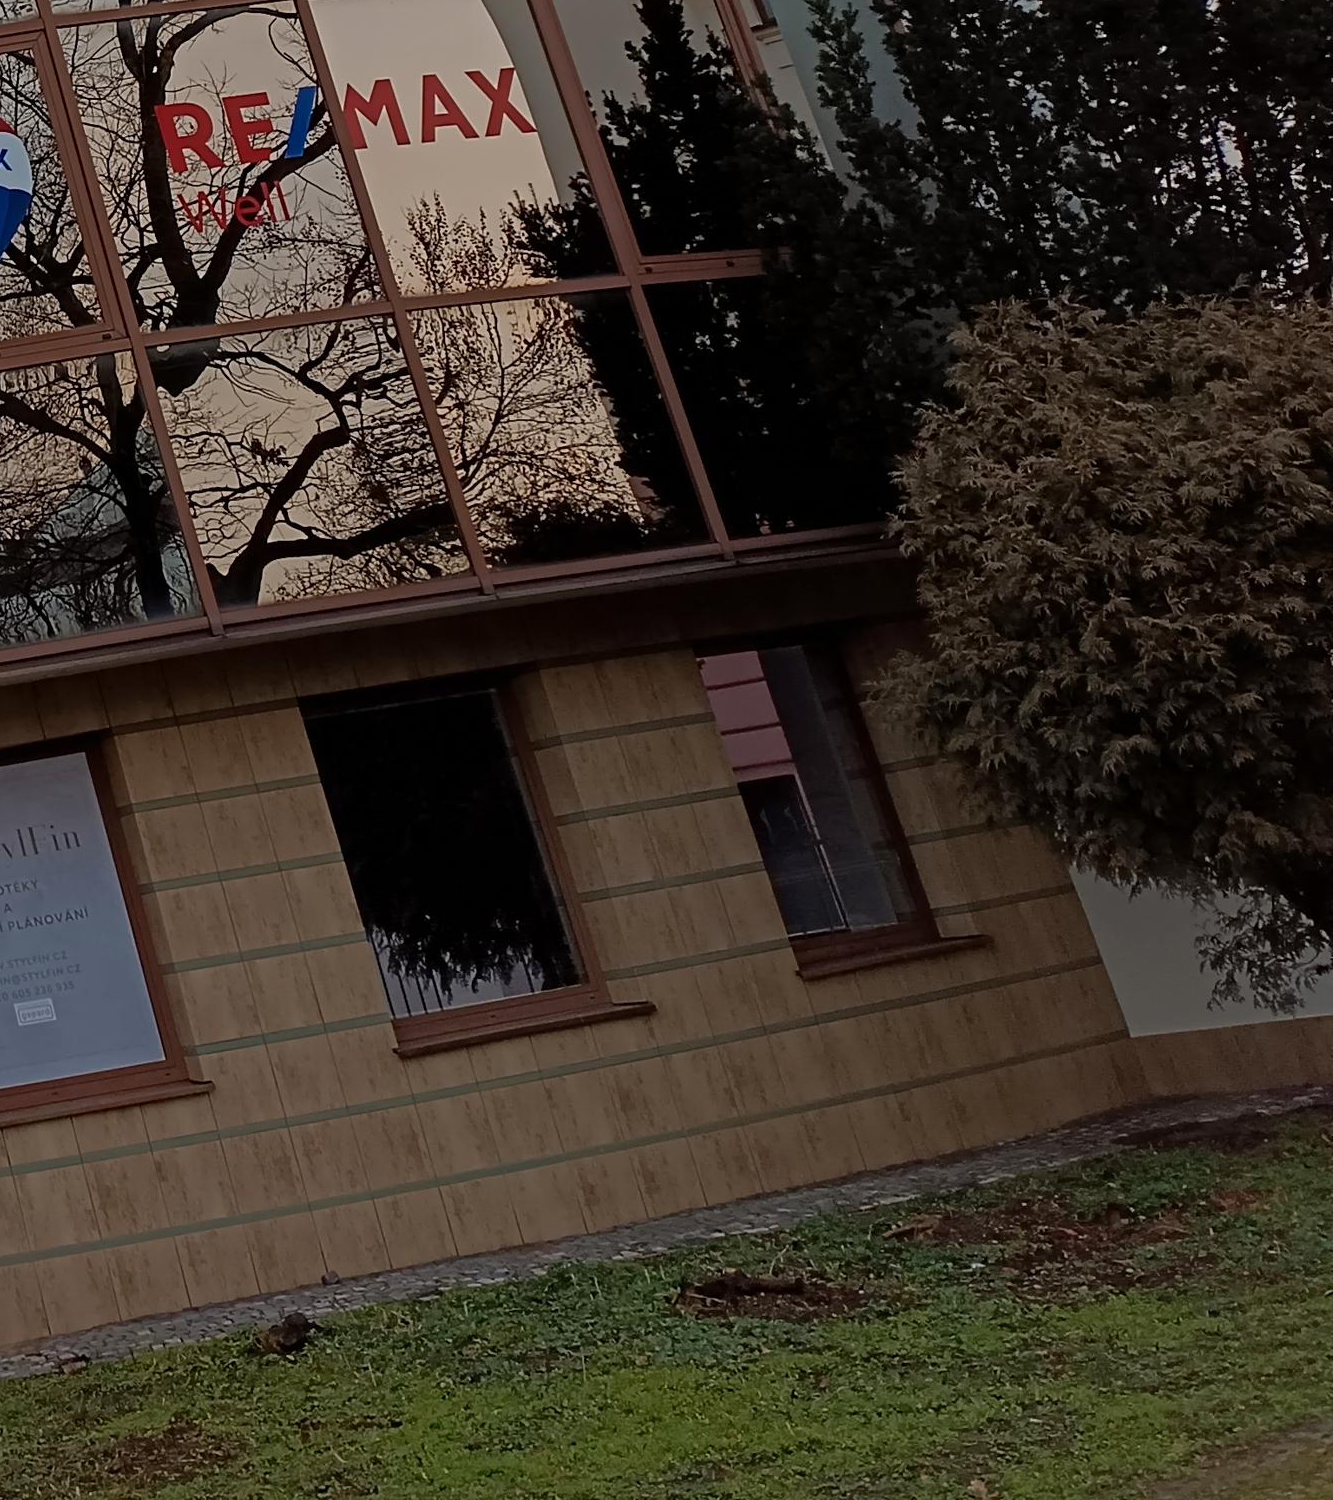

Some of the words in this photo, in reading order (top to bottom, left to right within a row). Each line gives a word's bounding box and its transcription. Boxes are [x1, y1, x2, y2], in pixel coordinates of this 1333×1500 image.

[156, 68, 538, 174] RE/MAX
[177, 179, 291, 235] Well
[3, 902, 13, 914] A
[8, 906, 89, 932] PLÁNOVÁNÍ
